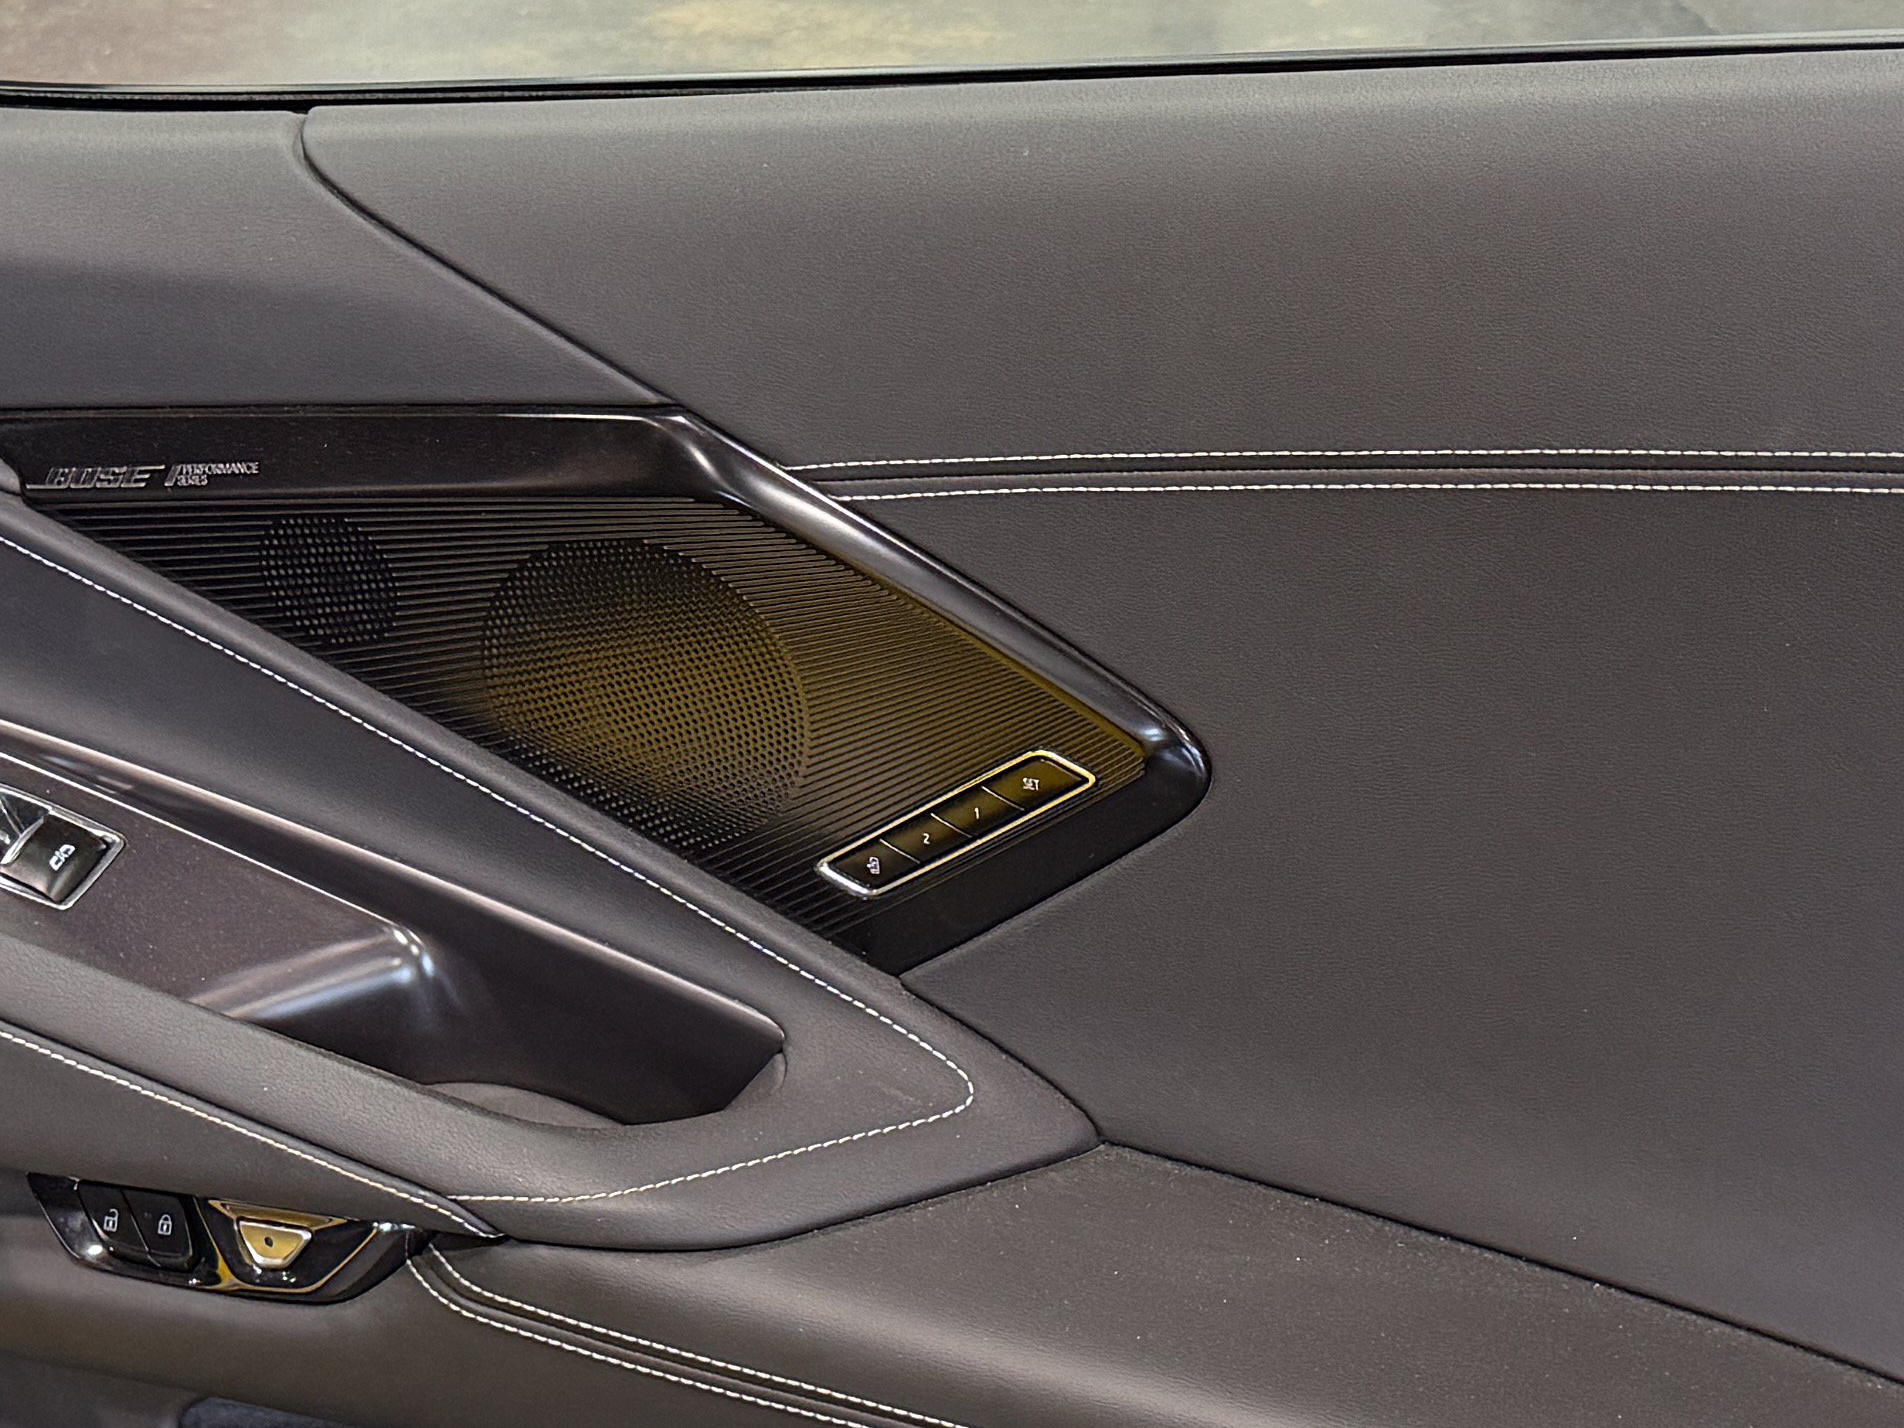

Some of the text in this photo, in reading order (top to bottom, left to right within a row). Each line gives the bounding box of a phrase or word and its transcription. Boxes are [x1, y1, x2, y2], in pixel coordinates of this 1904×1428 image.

[26, 461, 260, 490] BOSE PERFORMANCE
[1022, 777, 1040, 791] SET
[974, 806, 980, 820] 1
[923, 832, 931, 845] 2
